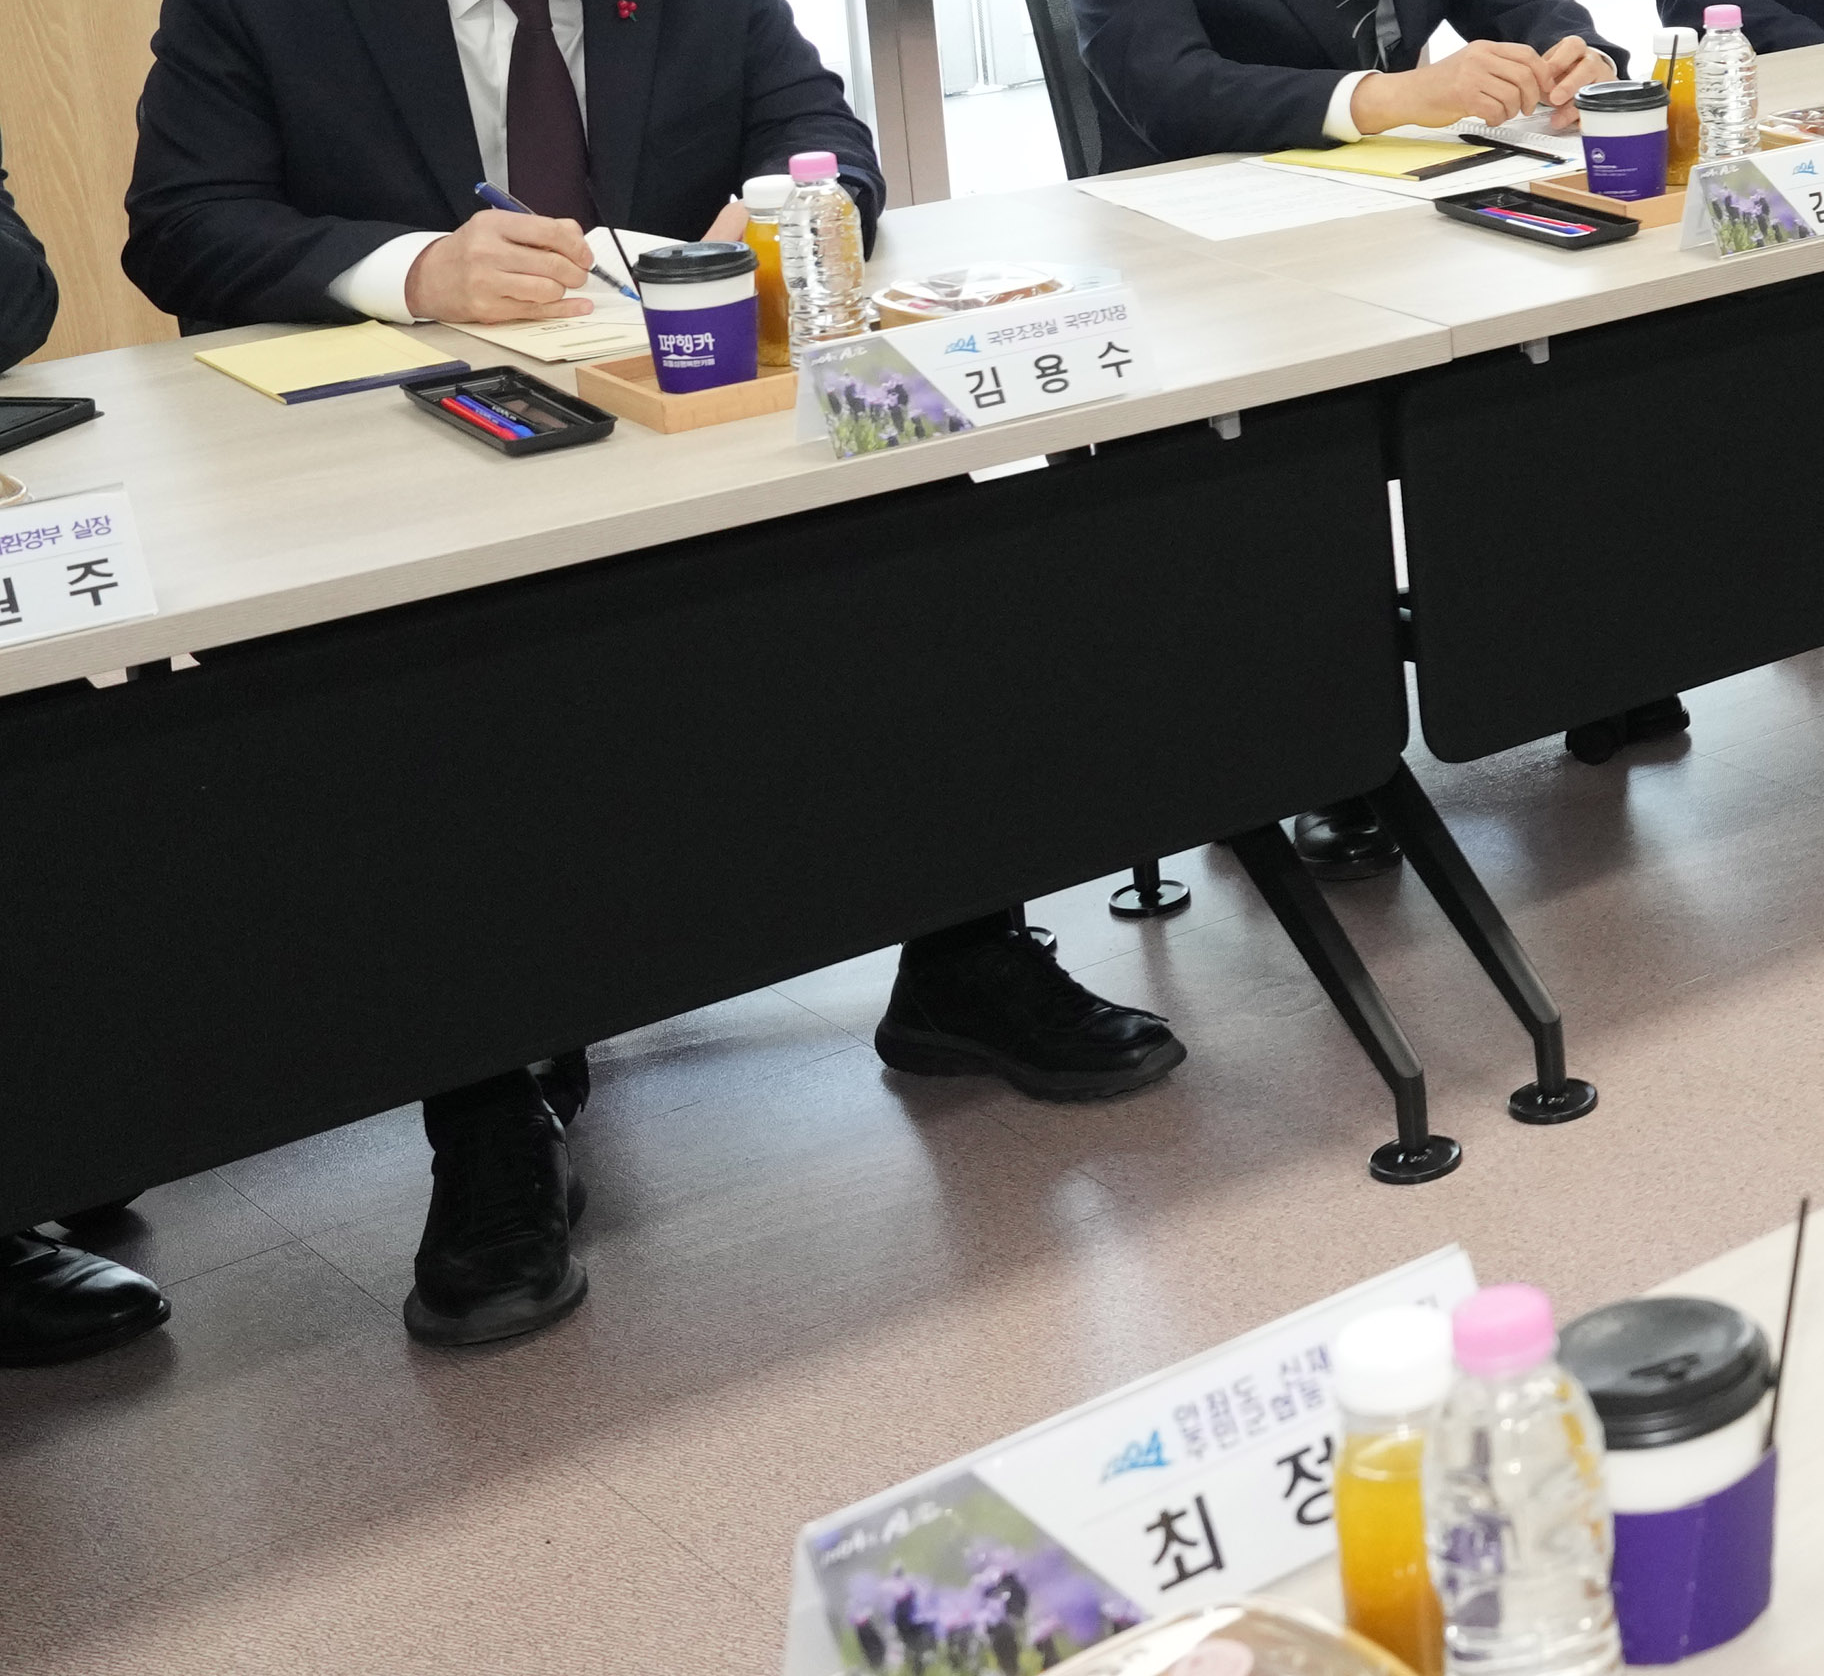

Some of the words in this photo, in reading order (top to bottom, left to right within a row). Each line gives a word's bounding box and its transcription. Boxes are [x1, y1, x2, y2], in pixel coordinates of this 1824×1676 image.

[988, 317, 1059, 346] 국무조정실
[1064, 303, 1128, 329] 국무2차장
[71, 515, 112, 540] 실장
